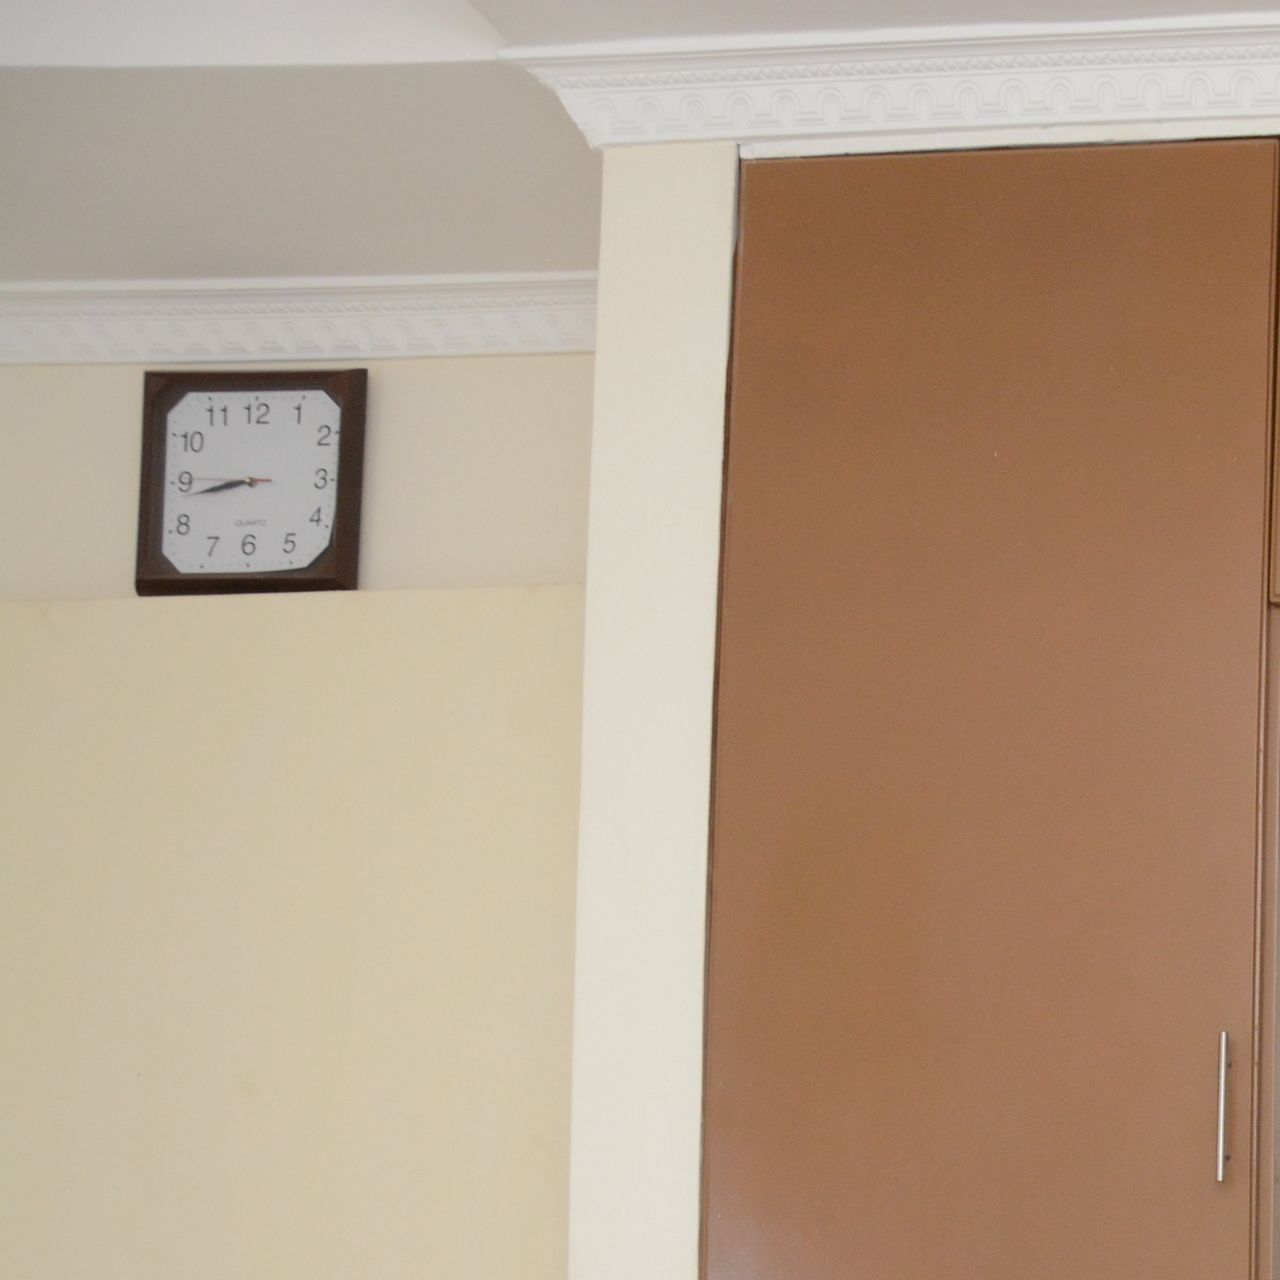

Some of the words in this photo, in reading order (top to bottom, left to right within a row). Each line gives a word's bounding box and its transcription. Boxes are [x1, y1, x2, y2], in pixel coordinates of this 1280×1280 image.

[206, 404, 228, 426] 11
[244, 403, 270, 425] 12
[294, 403, 302, 424] 1
[180, 431, 204, 453] 10
[317, 425, 331, 446] 2
[178, 471, 193, 493] 9
[314, 468, 328, 489] 3
[176, 514, 190, 535] 8
[309, 507, 322, 526] 4
[207, 536, 220, 557] 7
[241, 534, 256, 555] 6
[282, 533, 296, 554] 5
